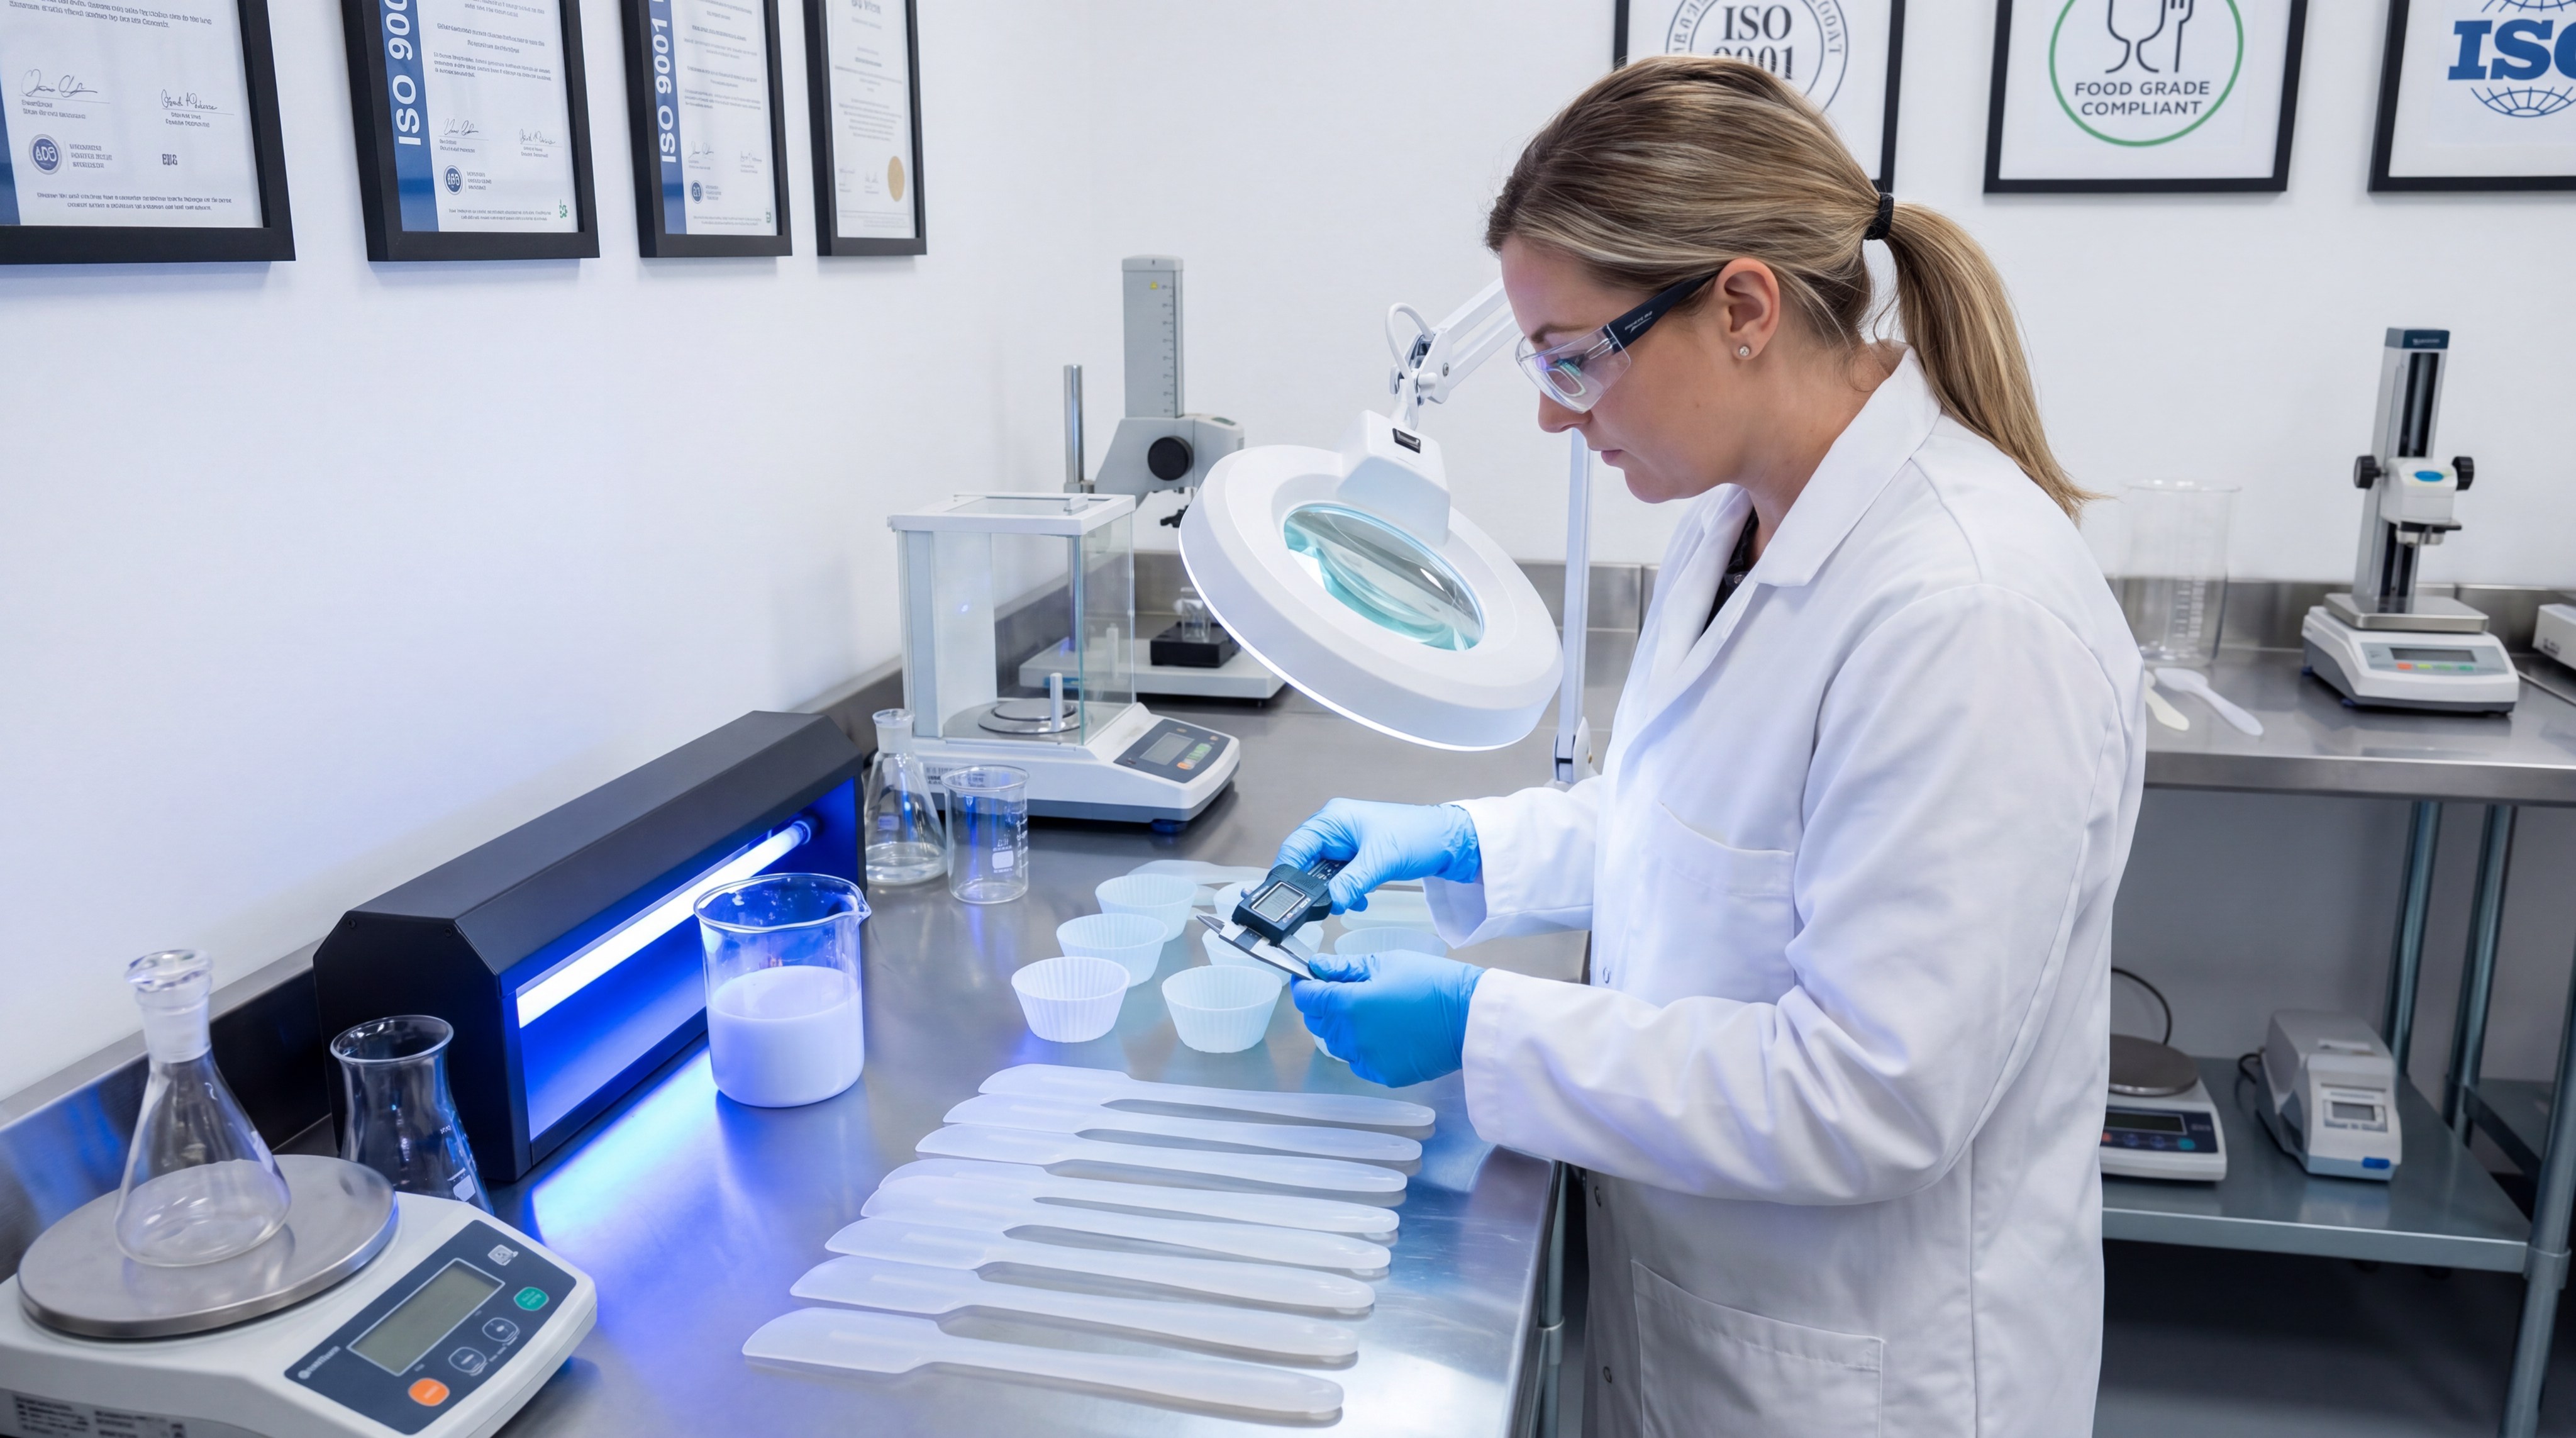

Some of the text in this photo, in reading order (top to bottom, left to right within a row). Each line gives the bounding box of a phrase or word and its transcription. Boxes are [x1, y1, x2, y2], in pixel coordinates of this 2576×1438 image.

[1721, 4, 1792, 41] ISO
[1713, 45, 1792, 80] 01
[652, 18, 677, 163] ISO 9001
[2075, 81, 2210, 96] FOOD GRADE
[392, 74, 421, 145] ISO
[2081, 101, 2202, 116] COMPLIANT
